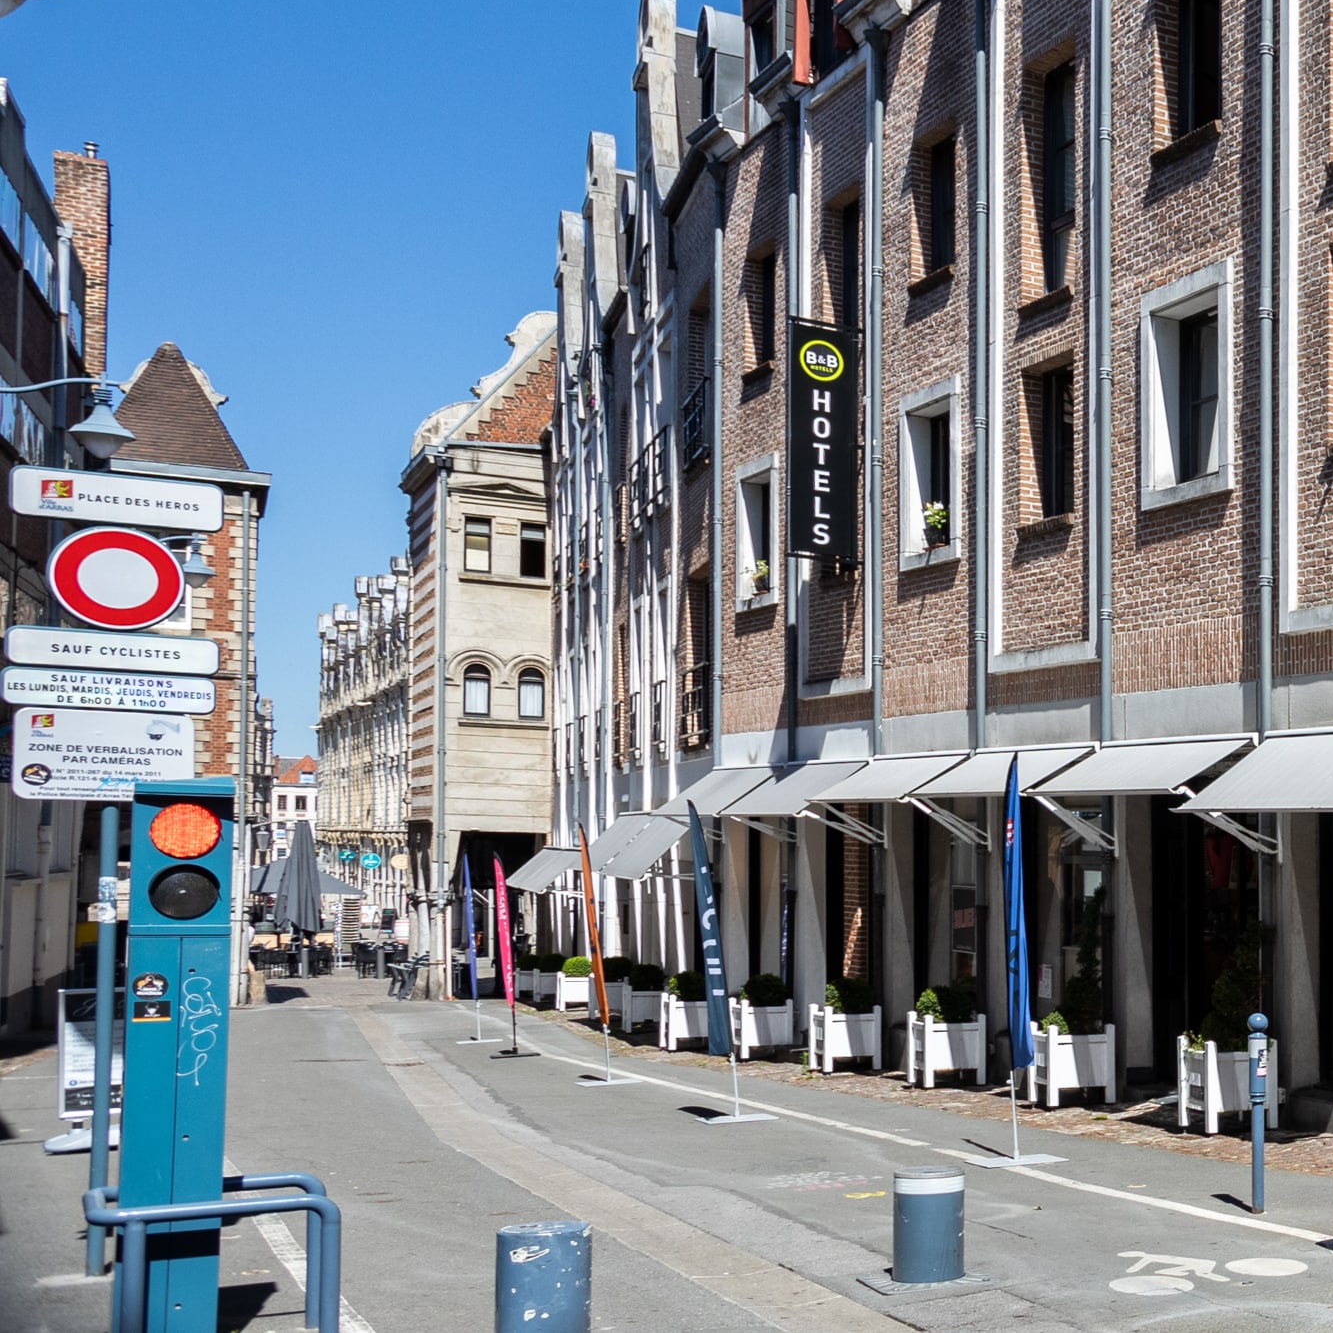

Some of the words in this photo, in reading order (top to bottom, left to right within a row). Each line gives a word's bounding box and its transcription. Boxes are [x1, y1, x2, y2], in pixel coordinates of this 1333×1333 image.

[805, 350, 838, 368] B&B
[810, 364, 833, 373] HOTELS
[812, 388, 831, 545] HOTELS
[78, 493, 119, 504] PLACE
[125, 497, 150, 507] DES
[156, 501, 200, 512] HEROS
[51, 643, 93, 655] SAUF
[100, 646, 182, 660] CYCLISTES
[51, 674, 87, 683] SAUF
[92, 677, 173, 688] LIVRAISONS
[7, 682, 26, 691] LES
[29, 683, 69, 694] LUNDIS,
[71, 686, 113, 695] MARDIS,
[116, 688, 154, 698] JEUDIS,
[157, 690, 212, 700] VENDREDIS
[57, 695, 74, 703] DE
[80, 696, 112, 705] 6h00
[132, 699, 166, 708] 11h00
[28, 743, 63, 753] ZONE
[66, 744, 83, 753] DE
[86, 745, 183, 756] VERBALISATION
[62, 755, 88, 764] PAR
[91, 755, 152, 766] CAMÉRAS
